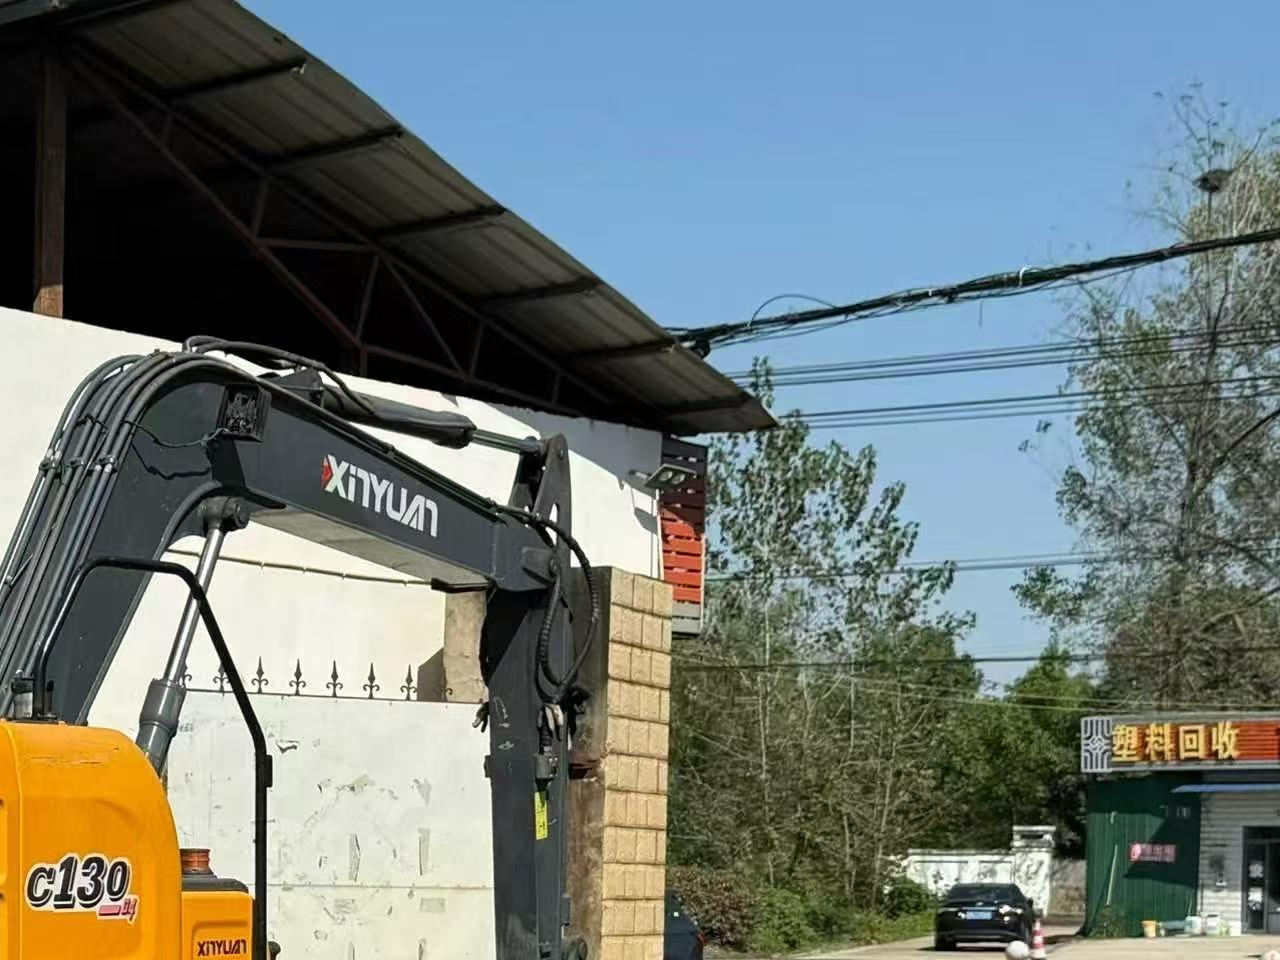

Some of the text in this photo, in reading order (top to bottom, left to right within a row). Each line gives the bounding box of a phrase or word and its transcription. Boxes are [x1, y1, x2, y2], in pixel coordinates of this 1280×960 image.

[1111, 720, 1239, 762] 塑料回收
[26, 855, 131, 909] C130
